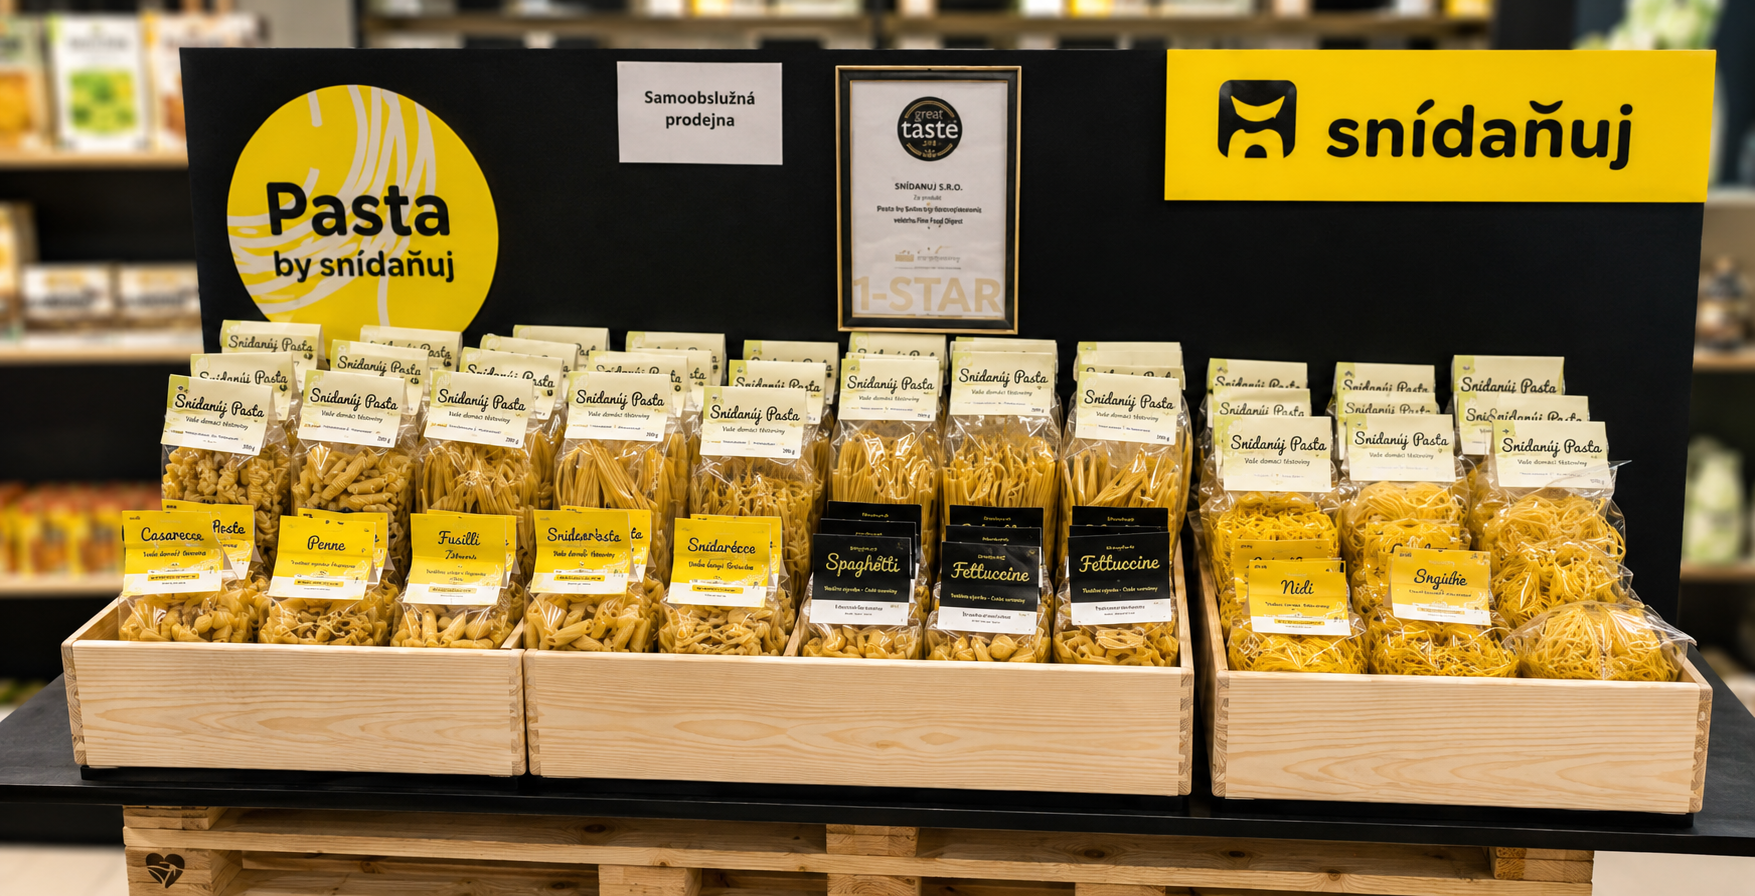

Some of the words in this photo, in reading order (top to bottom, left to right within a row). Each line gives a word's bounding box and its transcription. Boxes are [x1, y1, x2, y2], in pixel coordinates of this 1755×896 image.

[644, 90, 756, 106] Samoobslužná
[666, 112, 735, 130] prodejna
[914, 110, 944, 122] great
[900, 120, 959, 139] taste
[1326, 98, 1634, 170] snídaňuj
[938, 183, 964, 191] S.R.O.
[266, 182, 450, 236] Pasta
[274, 250, 312, 283] by
[320, 249, 454, 282] snídaňuj
[853, 276, 1003, 312] 1-STAR
[282, 337, 314, 352] Pasta
[254, 370, 288, 385] Pasta
[901, 376, 934, 390] Pasta
[1014, 369, 1049, 384] Pasta
[1520, 378, 1557, 394] Pasta
[364, 394, 398, 410] Pasta
[492, 394, 526, 411] Pasta
[631, 391, 665, 407] Pasta
[1140, 394, 1174, 410] Pasta
[231, 400, 264, 418] Pasta
[766, 406, 800, 422] Pasta
[1290, 436, 1327, 452] Pasta
[1412, 432, 1450, 447] Pasta
[1564, 438, 1602, 454] Pasta
[140, 526, 204, 542] Casarecce
[438, 530, 481, 546] Fusilli
[307, 534, 346, 552] Penne
[1078, 555, 1160, 574] Fettuccine
[1280, 579, 1314, 596] Nidi
